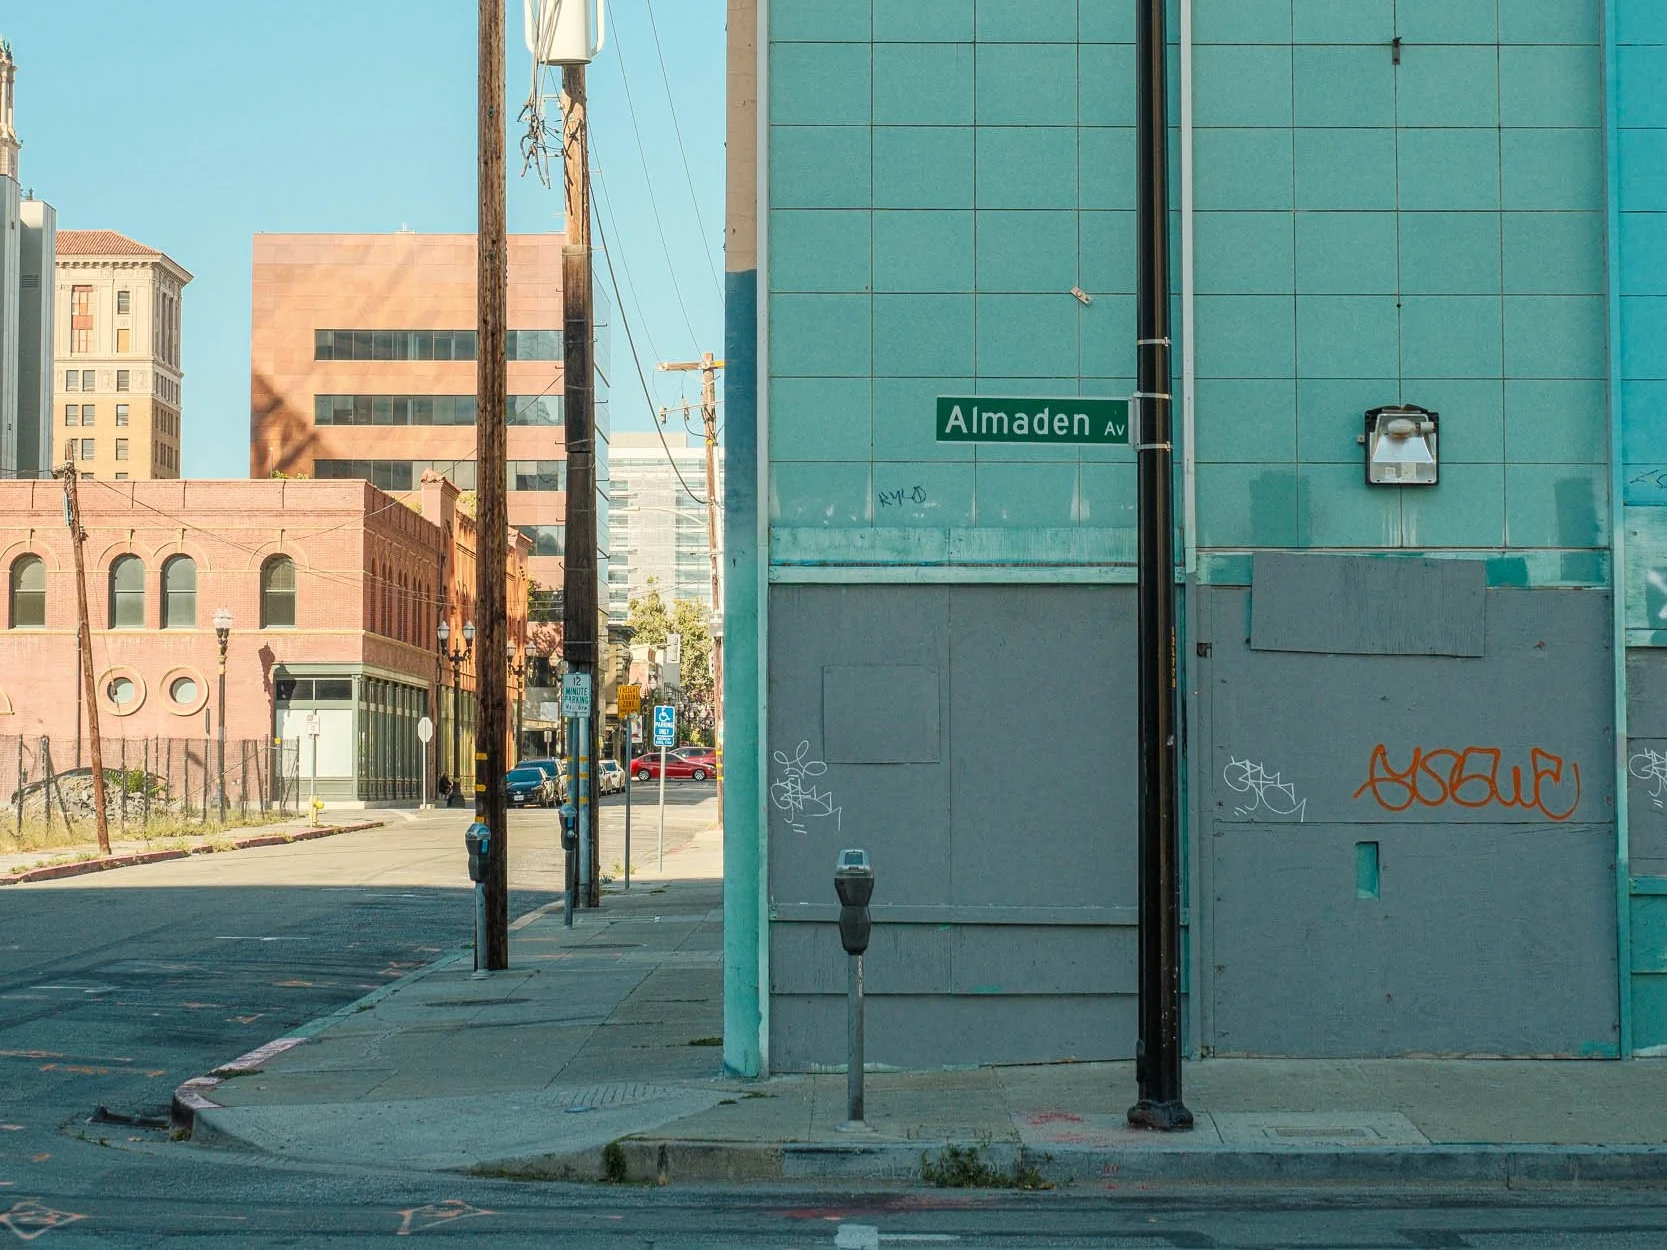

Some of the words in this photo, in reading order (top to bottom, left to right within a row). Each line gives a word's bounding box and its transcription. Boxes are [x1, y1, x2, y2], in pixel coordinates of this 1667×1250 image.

[945, 405, 1090, 436] Almaden
[1104, 421, 1125, 436] Av
[573, 676, 582, 686] 12
[565, 687, 588, 696] MINUTE
[564, 695, 589, 704] PARKING
